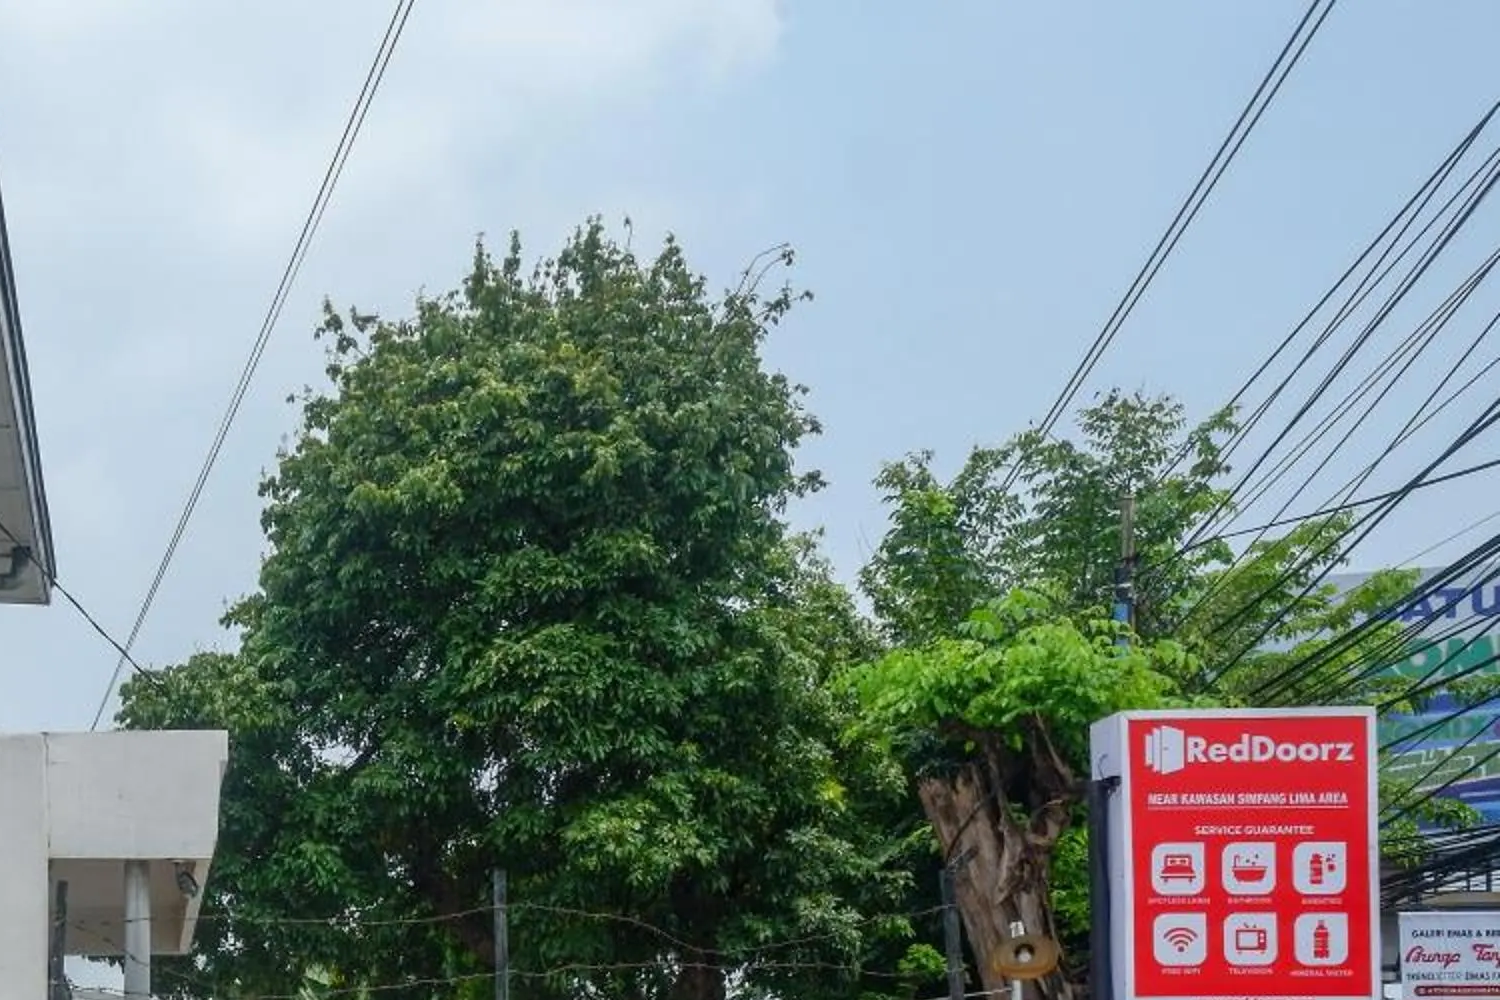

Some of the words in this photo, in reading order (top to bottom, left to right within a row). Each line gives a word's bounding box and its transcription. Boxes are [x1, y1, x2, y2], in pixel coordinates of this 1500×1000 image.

[1187, 733, 1355, 763] RedDoorz
[1148, 793, 1177, 805] NEAR
[1181, 793, 1235, 805] KAWASAN
[1237, 793, 1285, 805] SIMPANG
[1289, 792, 1316, 804] LIMA
[1319, 792, 1348, 804] AREA
[1194, 825, 1241, 835] SERVICE
[1244, 825, 1314, 835] GUARANTEE
[1412, 929, 1444, 938] GALERI
